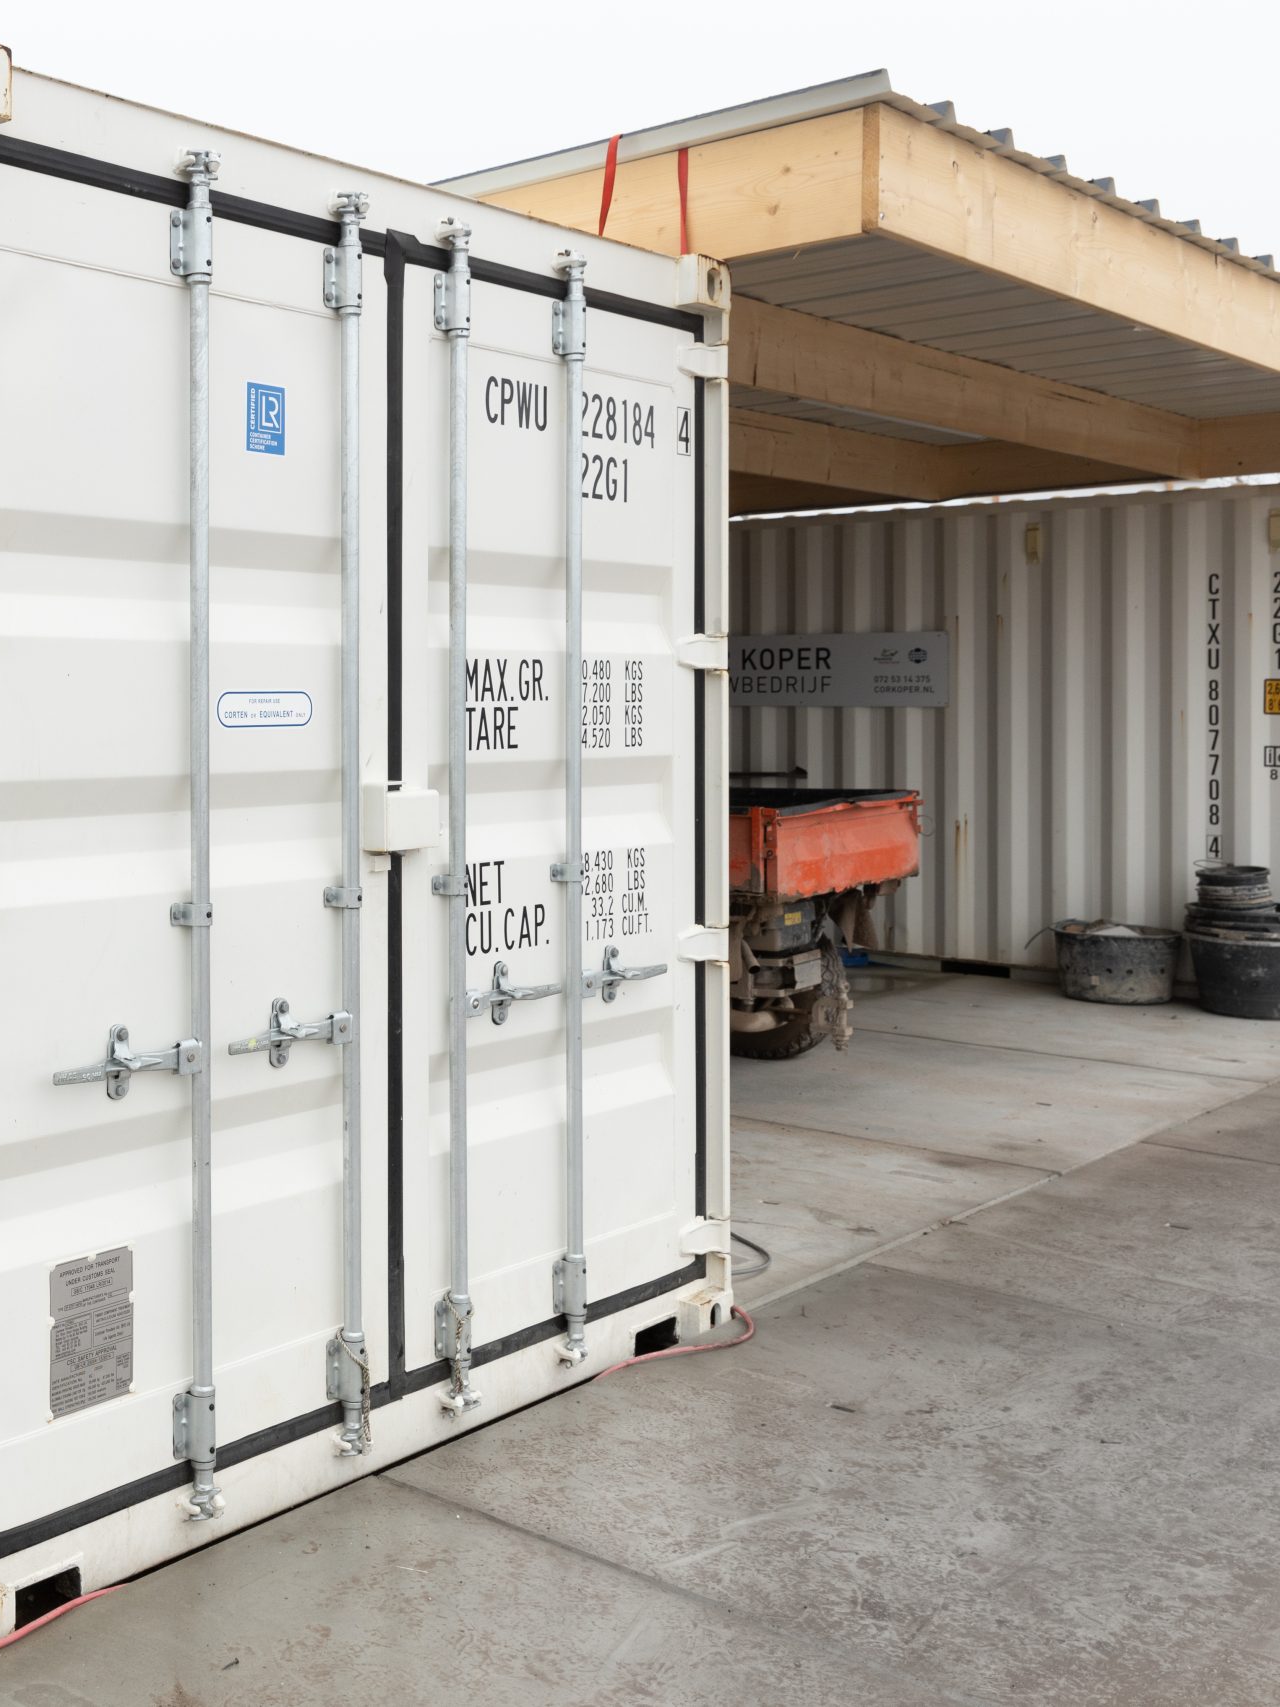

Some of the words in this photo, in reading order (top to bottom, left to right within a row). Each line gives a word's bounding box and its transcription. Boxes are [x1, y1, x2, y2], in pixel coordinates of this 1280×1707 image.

[485, 375, 548, 432] CPWU
[679, 410, 690, 454] 4
[1207, 573, 1220, 670] CTXU
[624, 660, 643, 681] KGS
[741, 647, 832, 671] KOPER
[624, 682, 643, 703] LBS
[729, 676, 832, 694] WBEDRIJF
[224, 711, 248, 719] CORTEN
[259, 710, 294, 719] EQUIVALENT
[465, 706, 518, 751] TARE
[624, 704, 643, 725] KGS
[624, 727, 643, 747] LBS
[1208, 679, 1220, 826] 807708
[1208, 836, 1220, 859] 4
[465, 860, 505, 908] NET
[627, 847, 645, 869] KGS
[627, 869, 646, 891] LBS
[591, 895, 614, 918] 33.2
